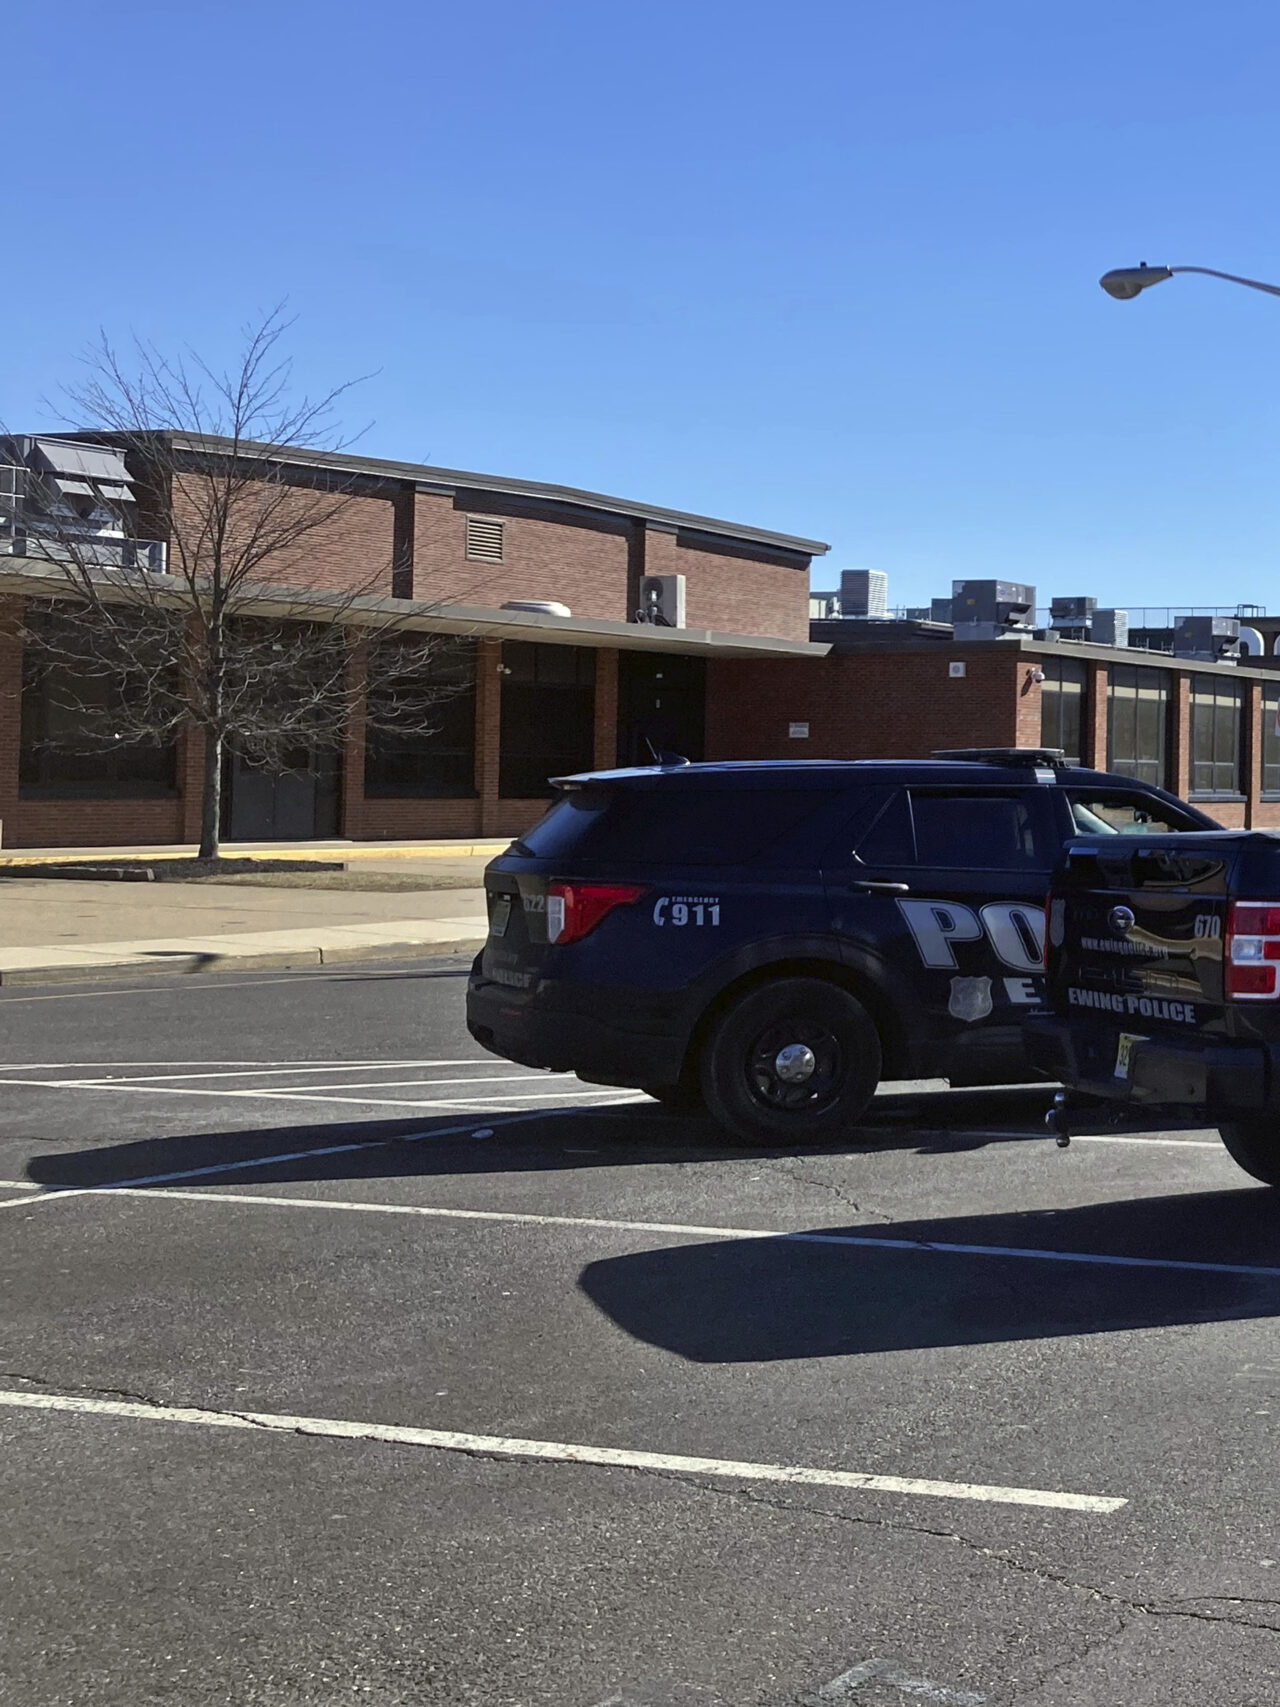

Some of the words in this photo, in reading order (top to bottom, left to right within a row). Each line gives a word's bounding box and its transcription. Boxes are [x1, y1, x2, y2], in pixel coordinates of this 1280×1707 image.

[671, 903, 720, 926] 911
[1193, 914, 1221, 939] 670
[1068, 987, 1125, 1013] EWING
[1127, 995, 1197, 1024] POLICE
